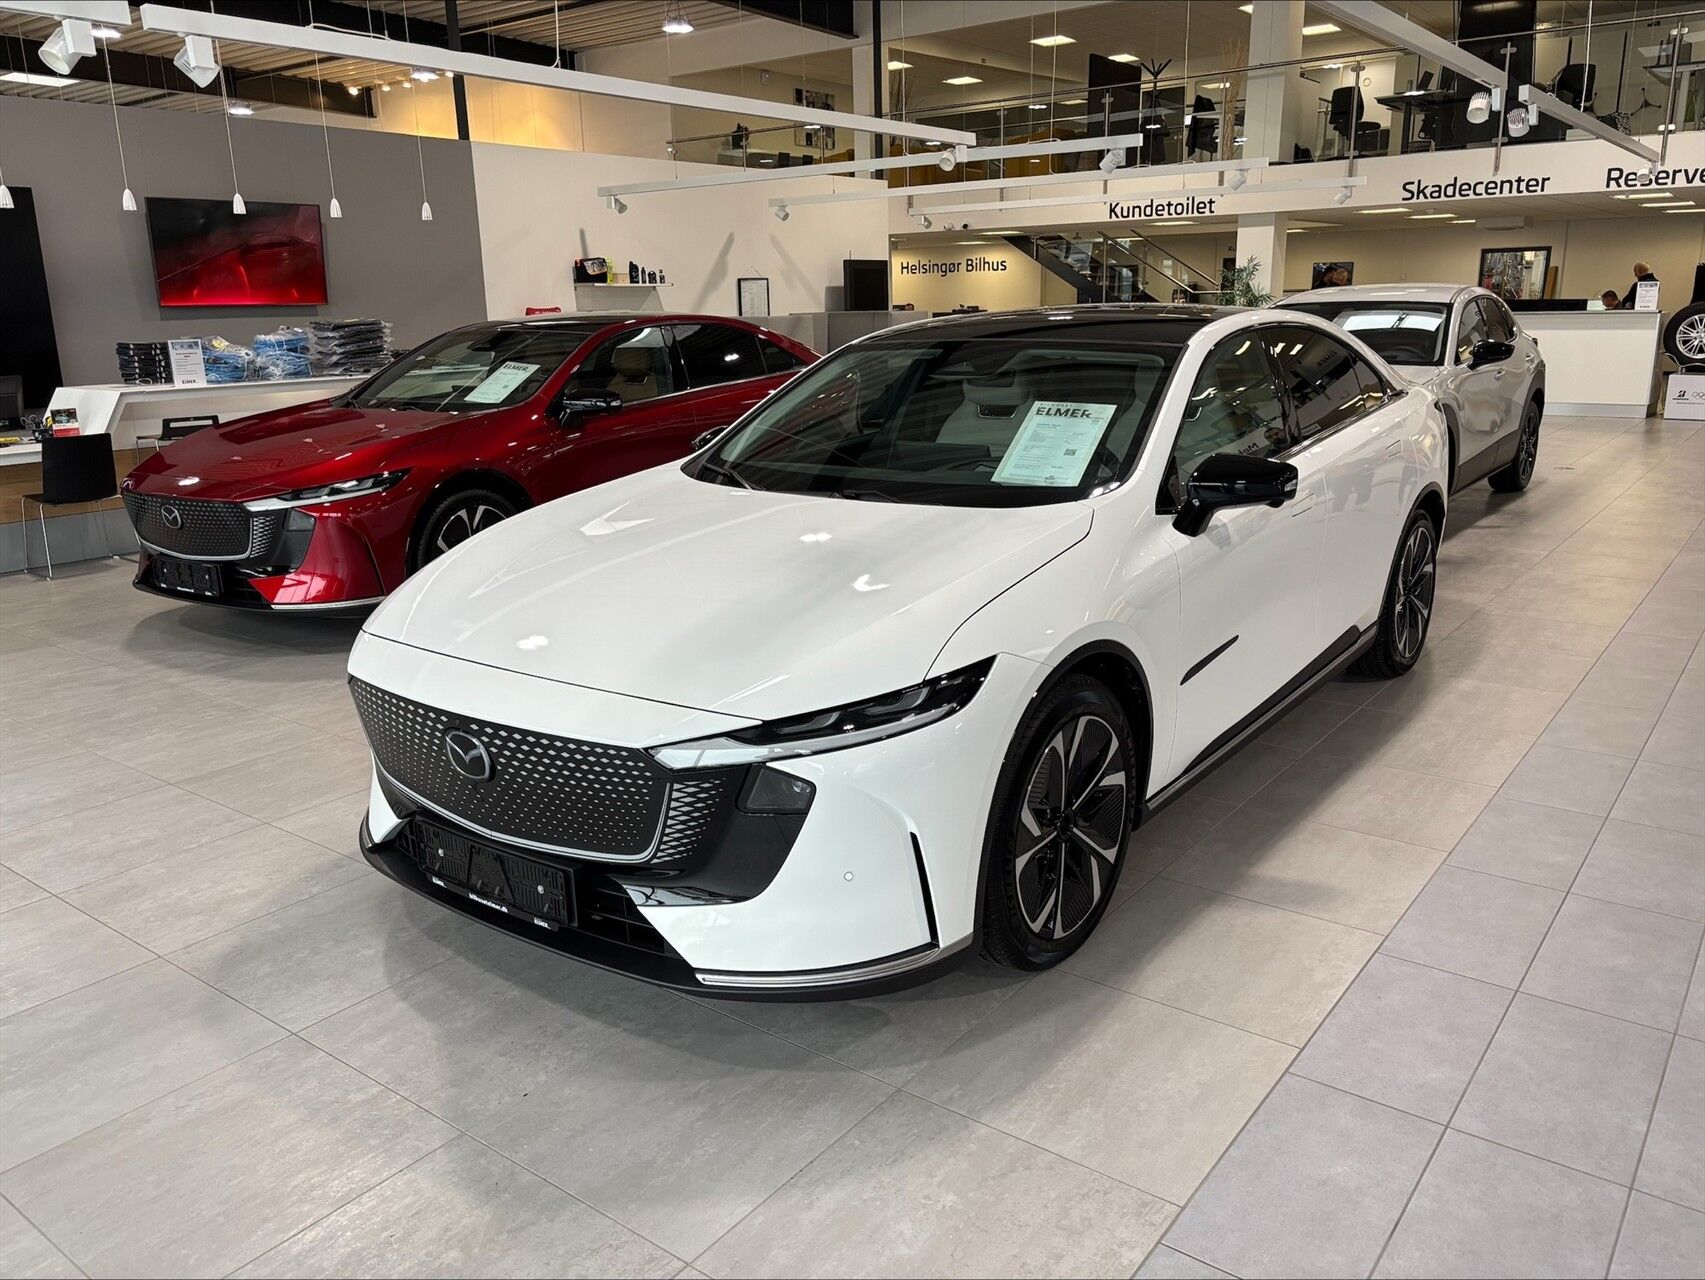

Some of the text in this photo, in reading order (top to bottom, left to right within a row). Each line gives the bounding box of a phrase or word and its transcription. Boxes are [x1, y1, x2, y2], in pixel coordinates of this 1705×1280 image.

[1401, 176, 1551, 201] Skadecenter
[1109, 196, 1216, 219] Kundetoilet
[900, 257, 1008, 278] Helsingør Bilhus
[1035, 406, 1092, 418] ELMER
